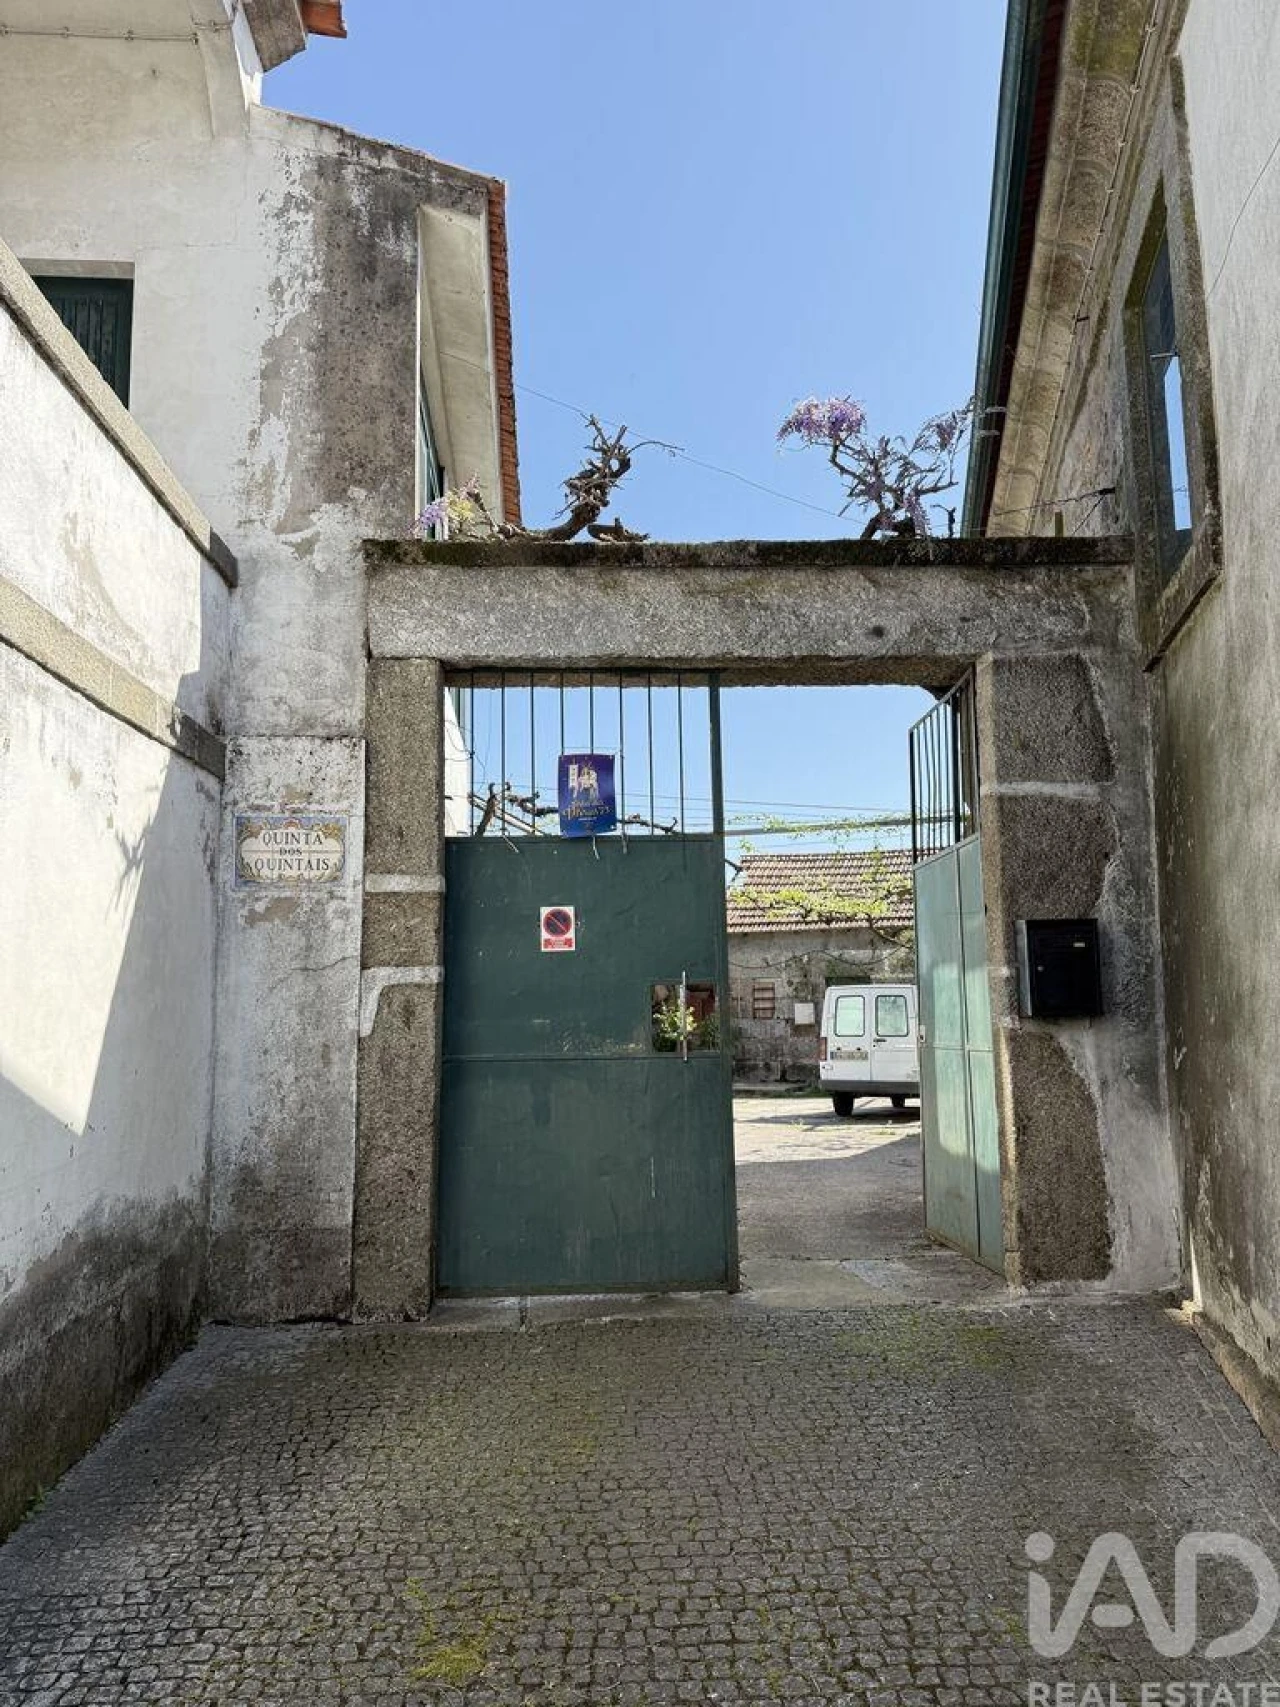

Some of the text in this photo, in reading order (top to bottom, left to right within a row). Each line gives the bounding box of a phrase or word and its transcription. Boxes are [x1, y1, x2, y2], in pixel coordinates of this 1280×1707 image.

[262, 831, 323, 846] QUINTA
[279, 847, 303, 856] DOS
[255, 858, 330, 872] QUINTAIS
